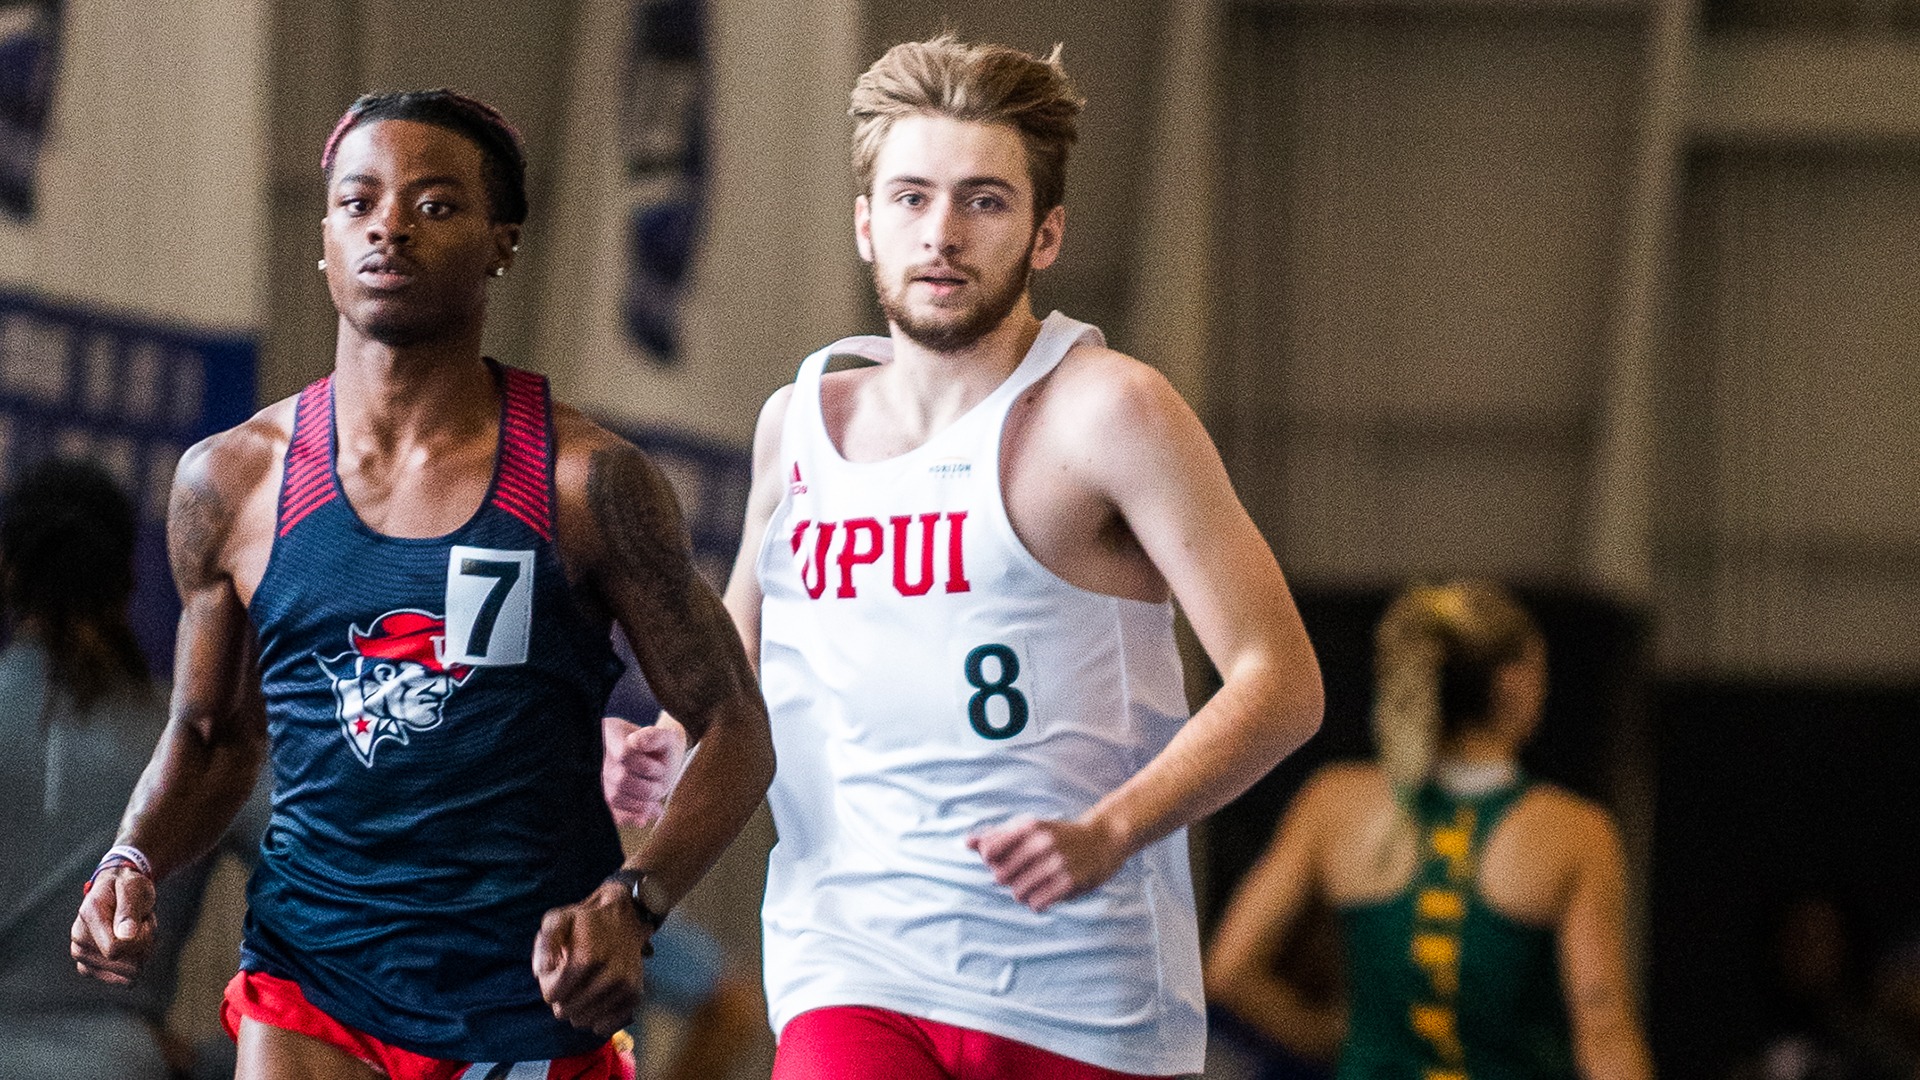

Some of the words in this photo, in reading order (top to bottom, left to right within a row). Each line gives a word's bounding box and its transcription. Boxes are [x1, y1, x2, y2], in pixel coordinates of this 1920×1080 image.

[790, 510, 971, 600] UPUI
[460, 558, 521, 658] 7
[964, 643, 1029, 740] 8
